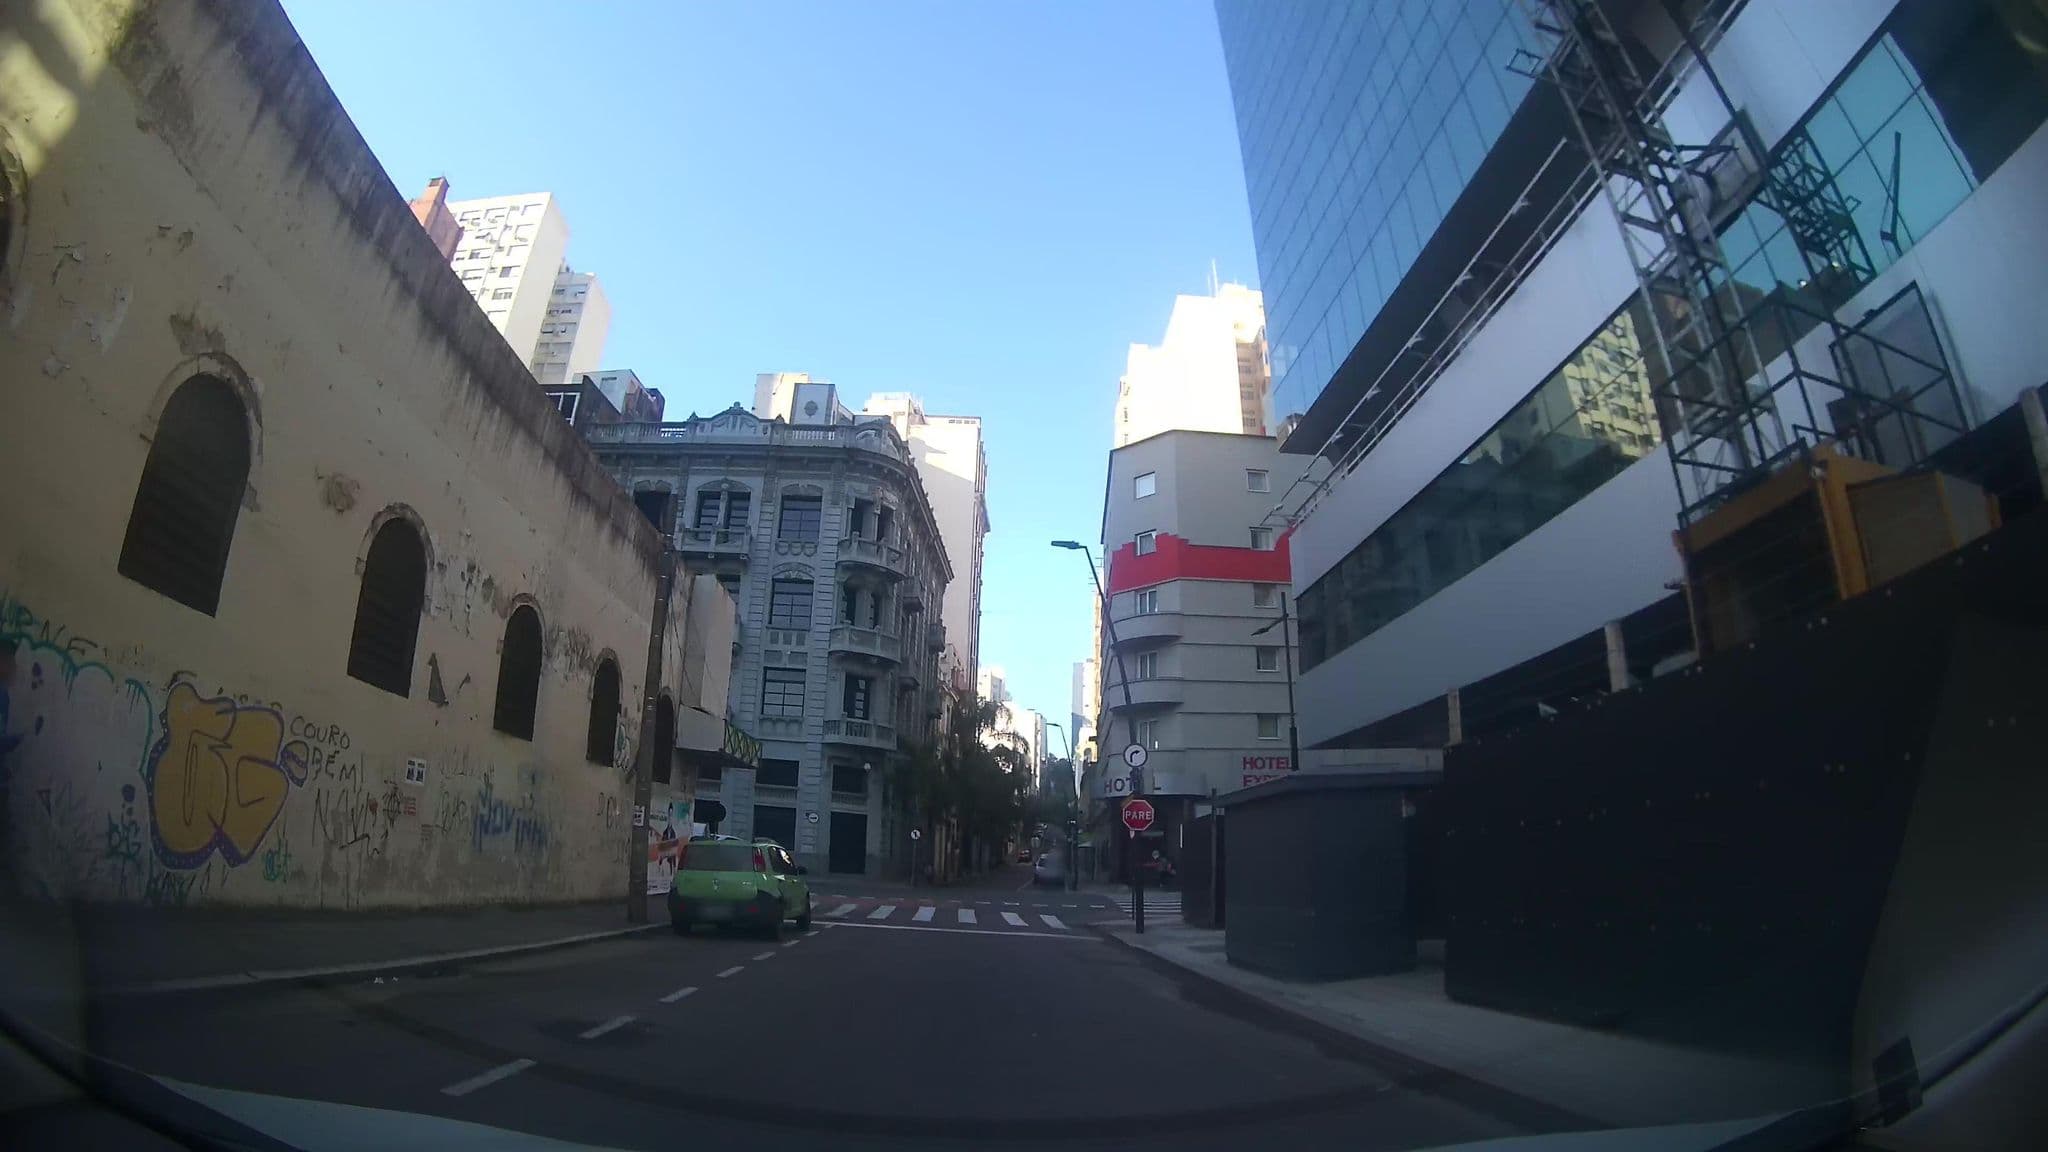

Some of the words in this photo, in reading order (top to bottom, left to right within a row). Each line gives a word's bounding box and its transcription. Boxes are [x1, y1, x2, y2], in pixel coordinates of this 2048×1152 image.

[290, 715, 351, 750] COURO
[1242, 756, 1292, 770] HOTEL
[1104, 776, 1162, 793] HOTL
[1125, 810, 1152, 820] PARE
